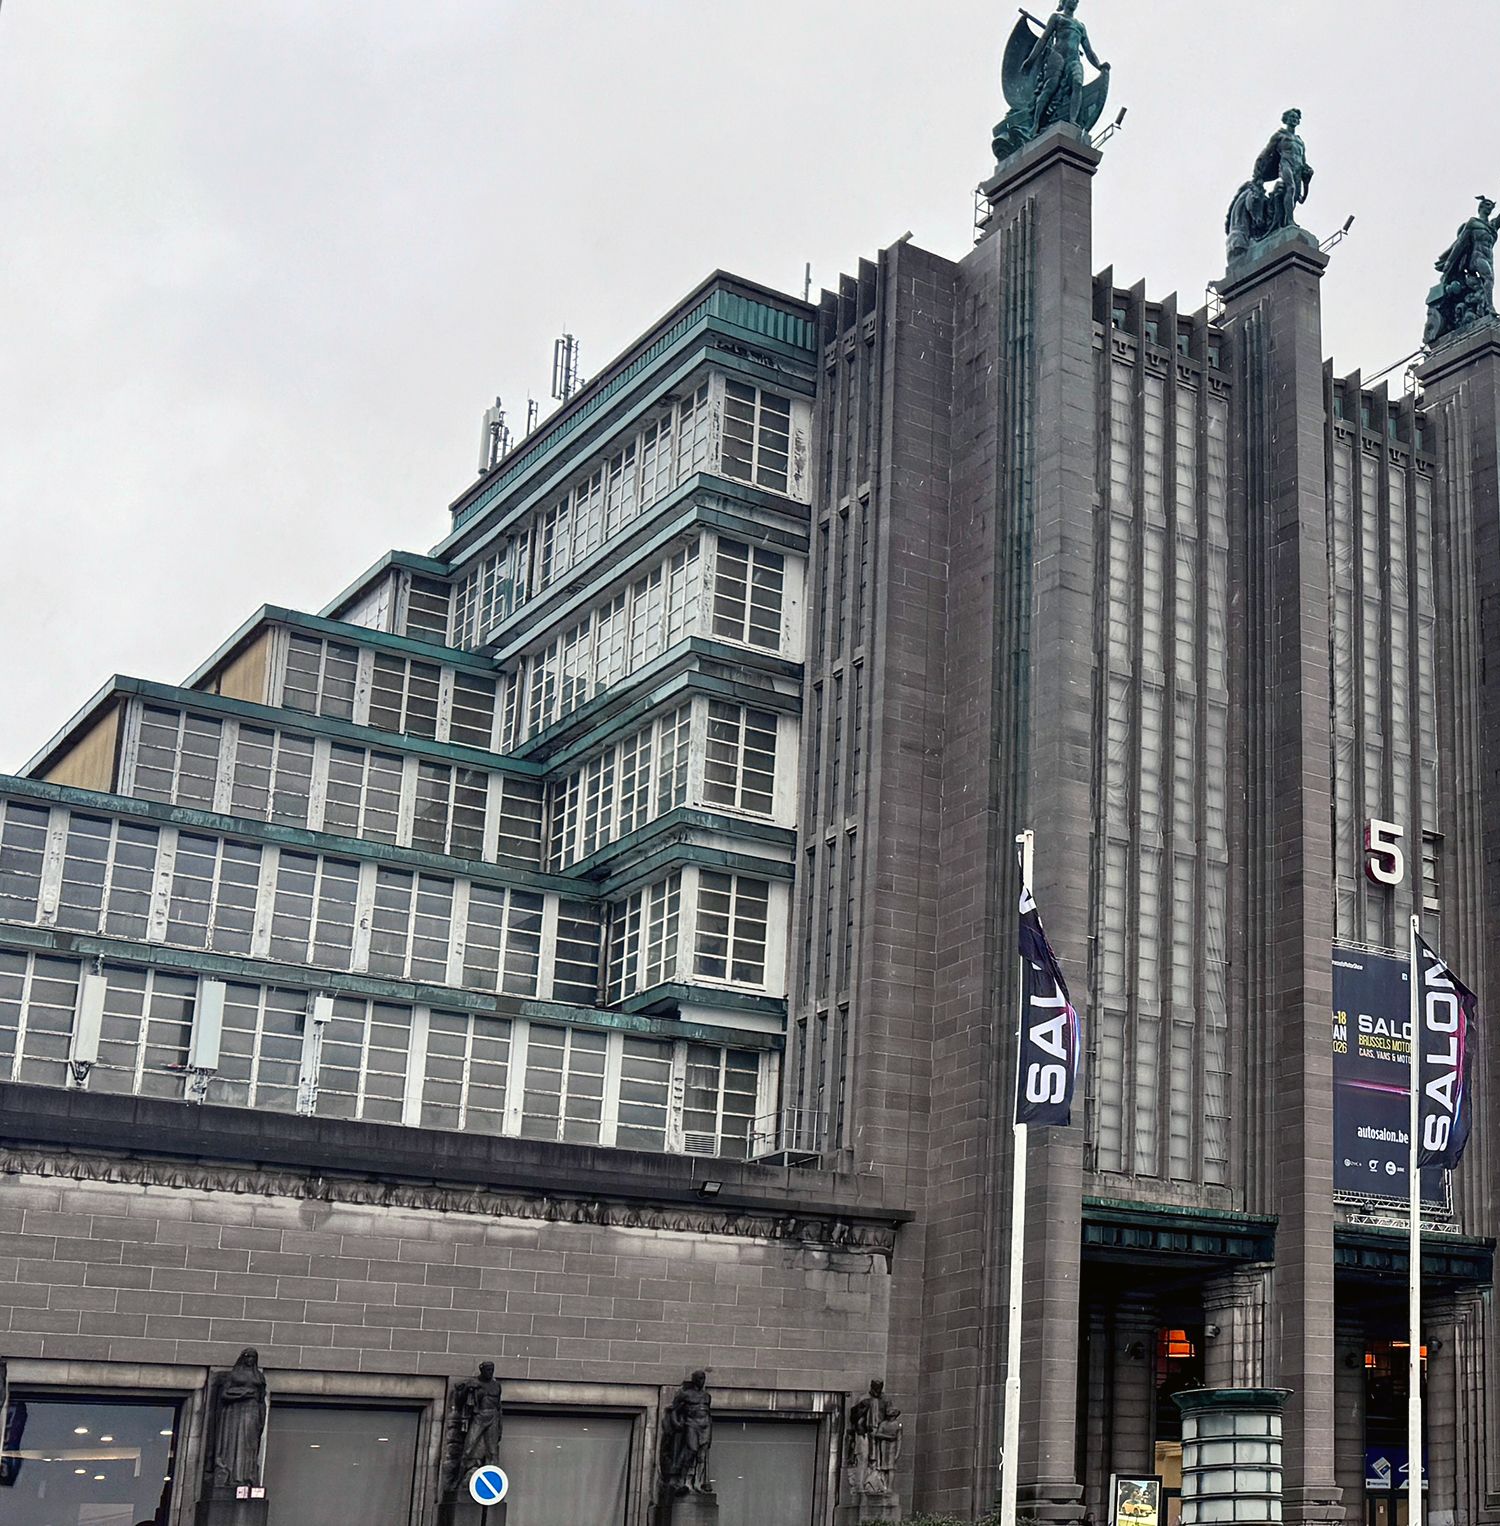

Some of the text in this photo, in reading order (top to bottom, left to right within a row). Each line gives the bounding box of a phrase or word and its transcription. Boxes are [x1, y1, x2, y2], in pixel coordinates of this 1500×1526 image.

[1366, 818, 1404, 886] 5
[1332, 1011, 1347, 1025] -18
[1358, 1014, 1411, 1040] SALO
[1026, 966, 1068, 1105] SAL
[1333, 1025, 1347, 1041] AN
[1333, 1041, 1348, 1054] 026
[1358, 1034, 1411, 1053] BRUSSELS MOTO
[1376, 1050, 1391, 1061] VANS
[1357, 1126, 1409, 1144] autosalon.be
